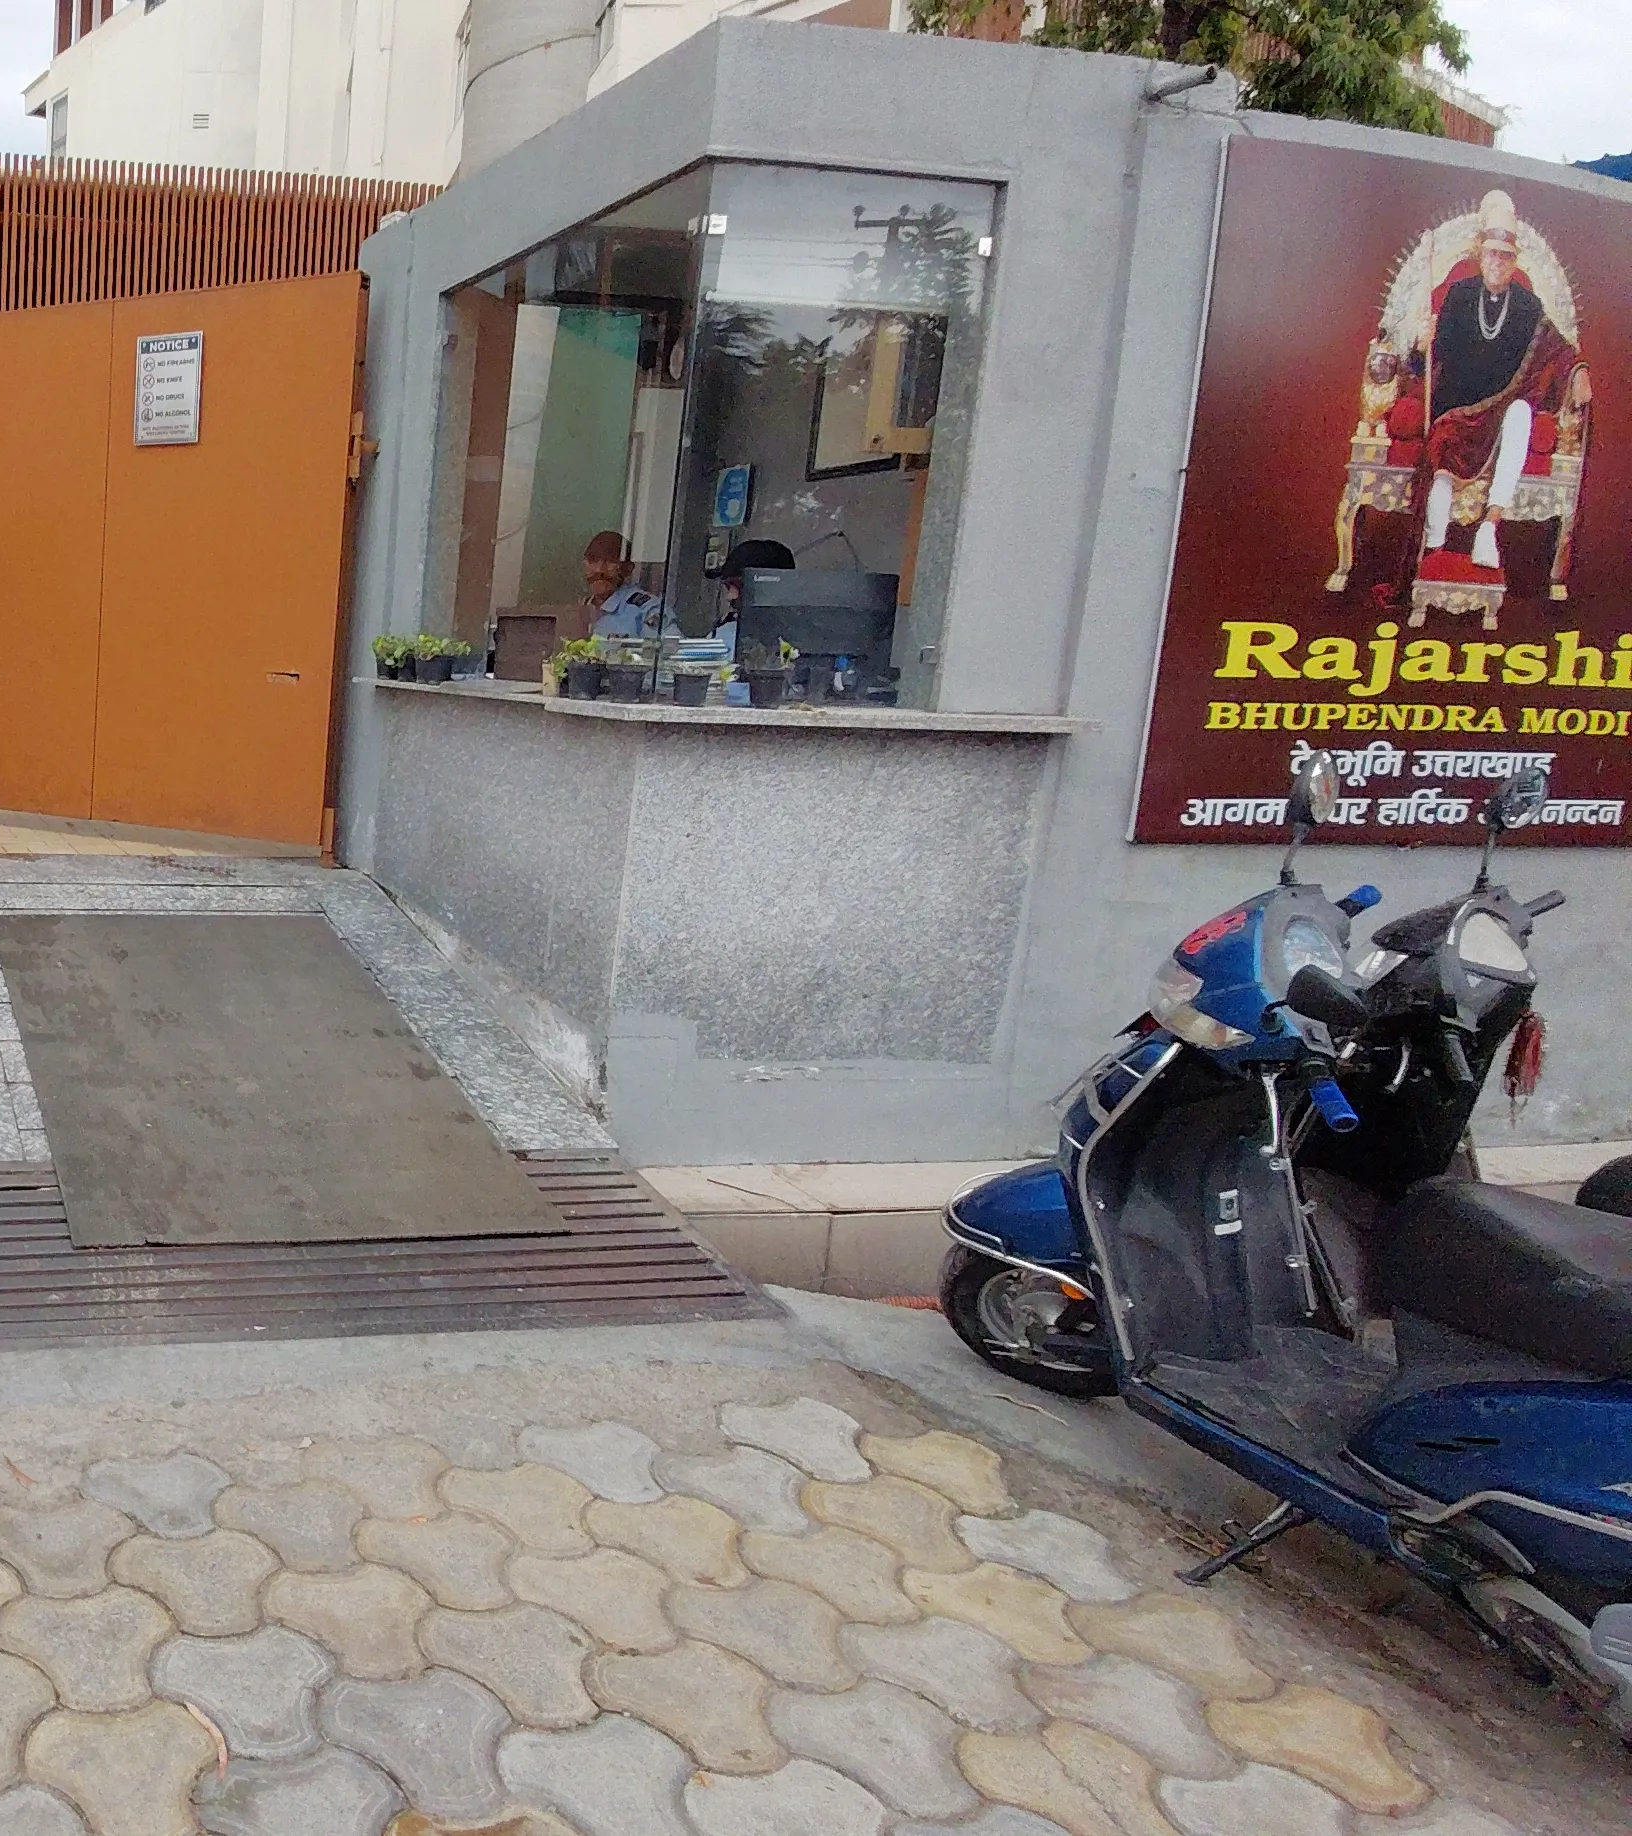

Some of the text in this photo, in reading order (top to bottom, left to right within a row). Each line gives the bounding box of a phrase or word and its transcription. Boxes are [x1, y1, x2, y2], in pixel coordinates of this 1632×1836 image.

[149, 339, 190, 353] NOTICE
[1213, 620, 1632, 697] Rajarshi
[1204, 701, 1632, 736] BHUPENDRA MODI
[1290, 739, 1406, 787] देभूमि
[1180, 798, 1298, 826] आगम
[1376, 787, 1474, 826] हार्दिक
